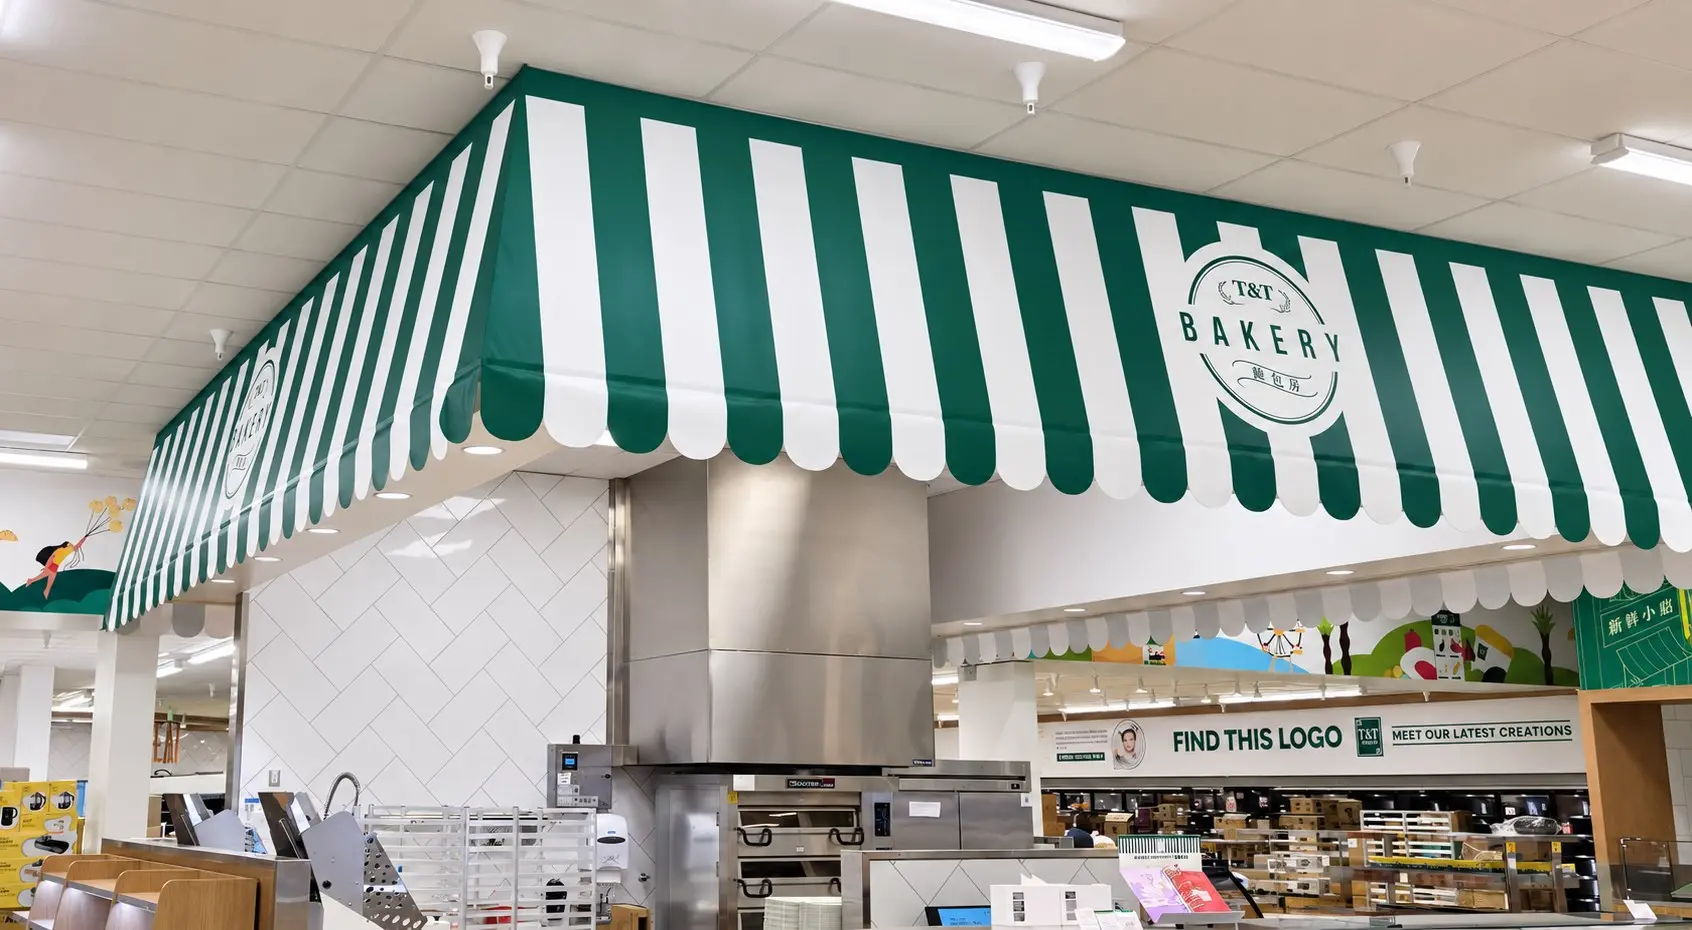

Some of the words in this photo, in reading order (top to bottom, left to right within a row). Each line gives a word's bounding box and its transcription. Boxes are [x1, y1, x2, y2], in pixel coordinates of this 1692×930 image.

[1231, 279, 1273, 301] T&T
[1179, 311, 1340, 362] BAKERY
[229, 401, 272, 453] BAKERY
[1173, 730, 1220, 752] FIND
[1224, 727, 1273, 751] THIS
[1278, 725, 1342, 750] LOGO
[1358, 728, 1379, 740] T&T
[1392, 730, 1421, 741] MEET
[1425, 729, 1450, 740] OUR
[1453, 727, 1495, 739] LATEST
[1499, 725, 1572, 737] CREATIONS
